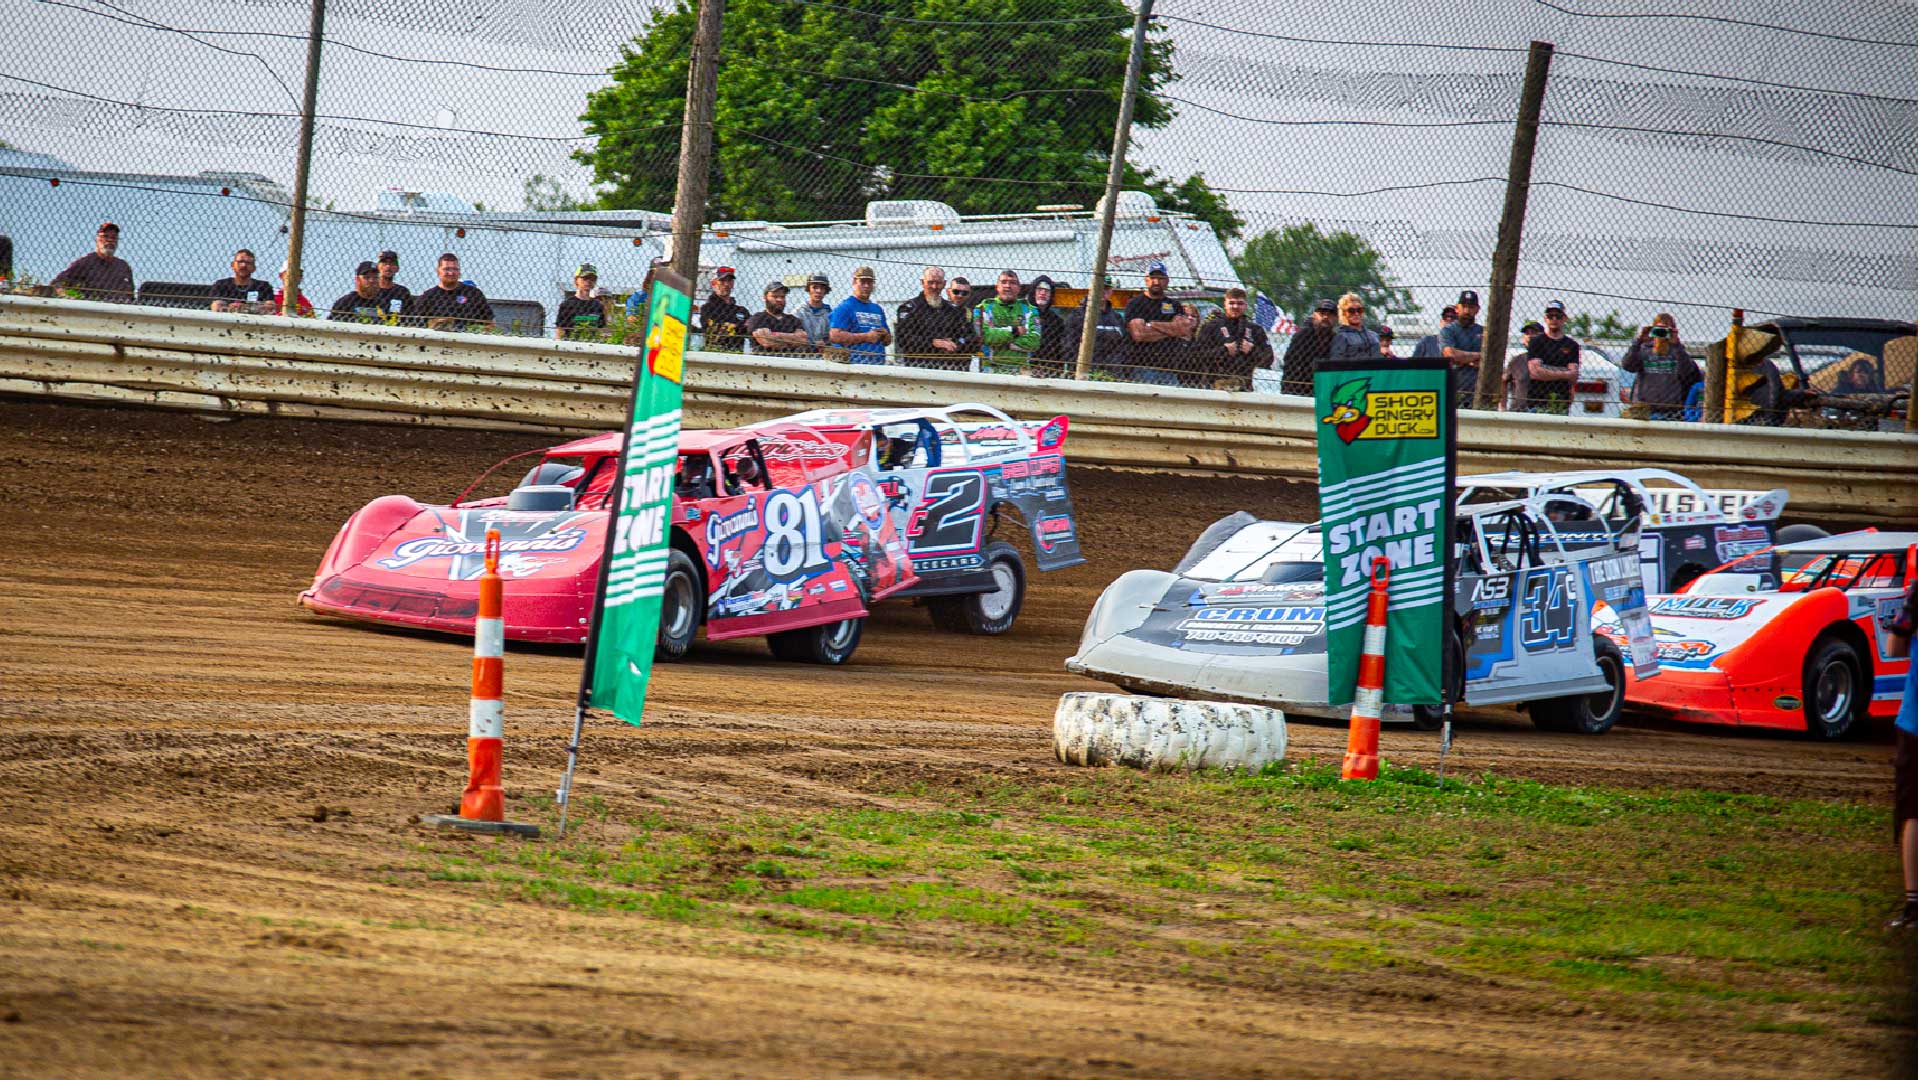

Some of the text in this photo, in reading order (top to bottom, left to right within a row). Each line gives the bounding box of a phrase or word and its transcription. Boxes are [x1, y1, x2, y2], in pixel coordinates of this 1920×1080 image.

[1375, 395, 1434, 408] SHOP
[1375, 409, 1434, 421] ANGRY
[763, 484, 832, 578] 81
[908, 468, 983, 556] 2
[1329, 498, 1441, 555] START
[1340, 533, 1436, 588] ZONE
[1197, 608, 1326, 621] CRUM
[1521, 569, 1575, 649] 34
